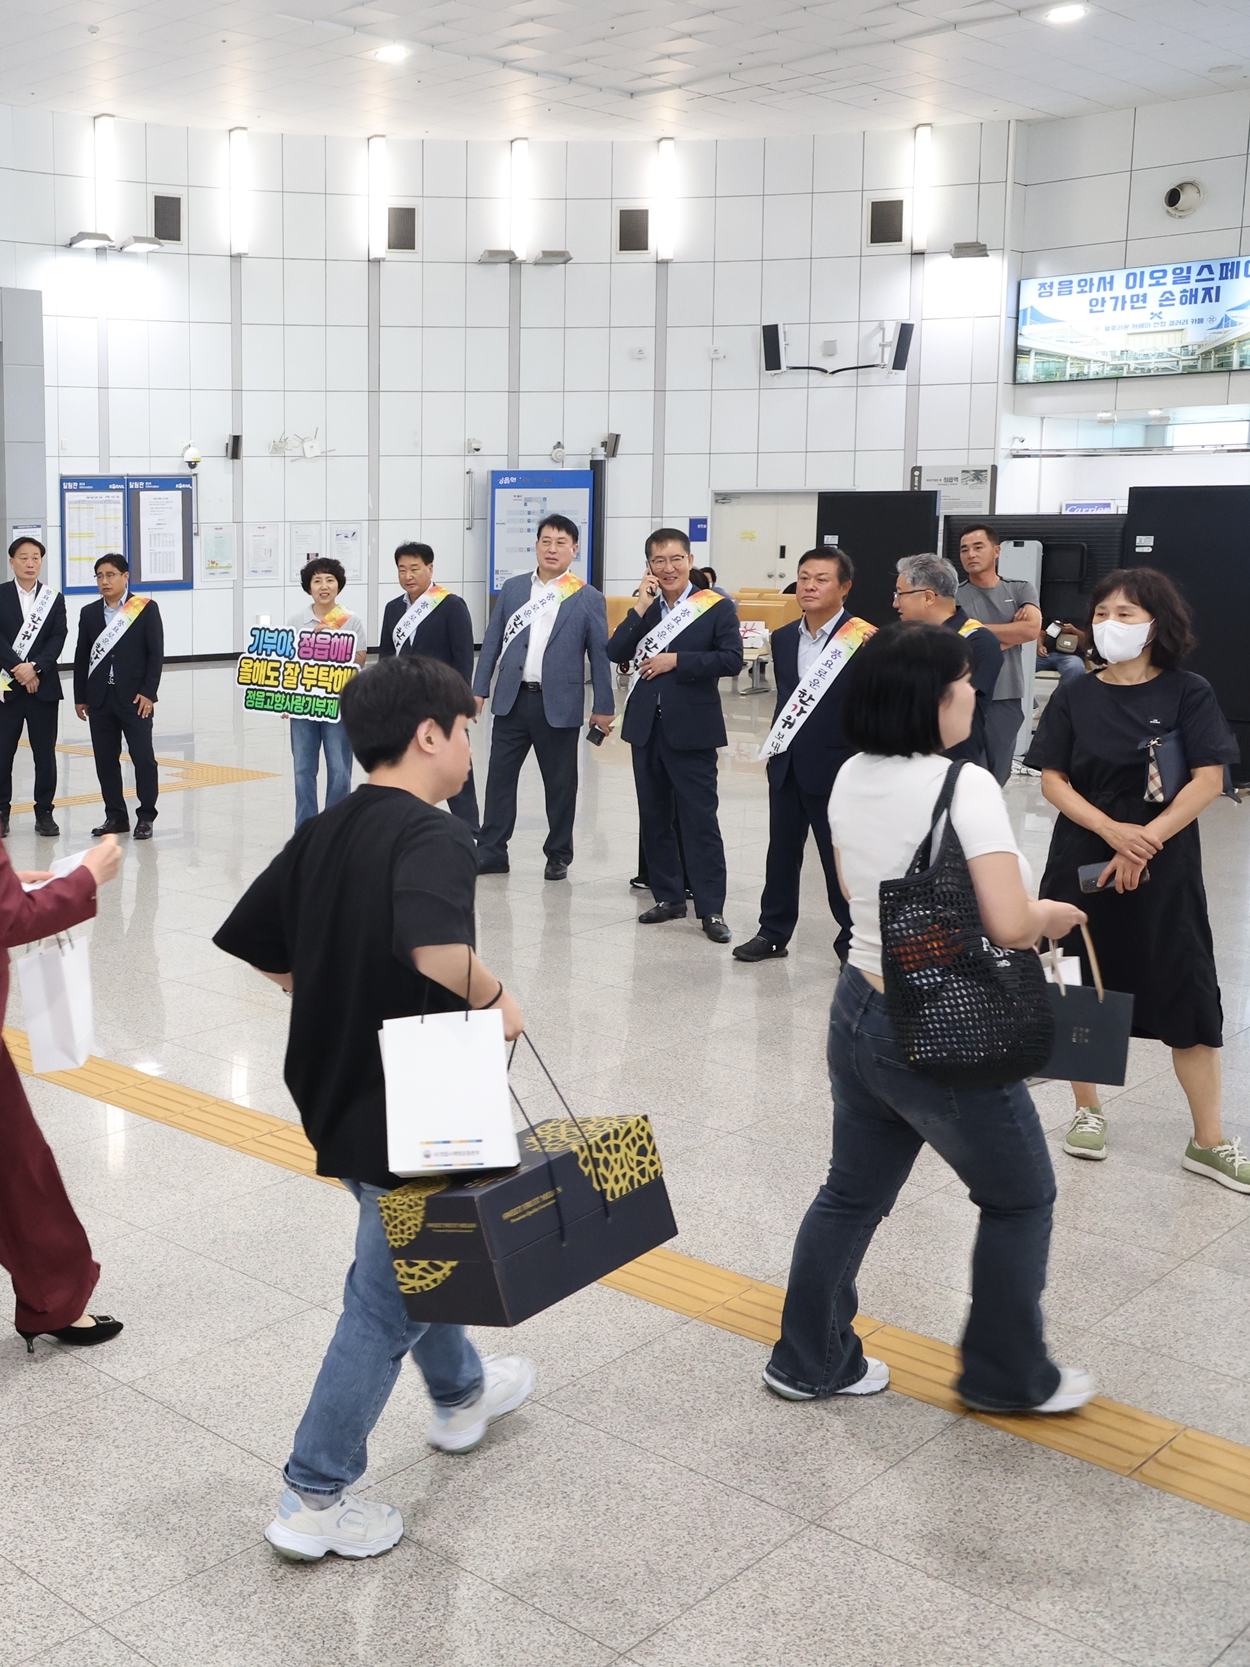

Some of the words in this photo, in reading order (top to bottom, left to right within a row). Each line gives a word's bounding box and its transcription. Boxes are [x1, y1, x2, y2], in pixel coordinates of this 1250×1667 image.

[1037, 275, 1115, 298] 정읍와서
[1088, 293, 1148, 314] 안가면
[1158, 286, 1221, 308] 손해지
[36, 588, 53, 614] 풍요로운
[402, 600, 429, 630] 풍요로운
[523, 592, 557, 618] 풍요로운
[21, 613, 43, 641] 한가위
[102, 618, 126, 647] 풍요로운
[656, 607, 691, 641] 풍요로운
[248, 629, 296, 658] 기부야,
[298, 632, 354, 661] 정읍해!
[238, 658, 281, 687] 올해도
[282, 663, 300, 689] 잘
[808, 648, 843, 691] 풍요로운
[245, 690, 339, 718] 정읍고향사랑기부제
[780, 689, 816, 730] 한가위
